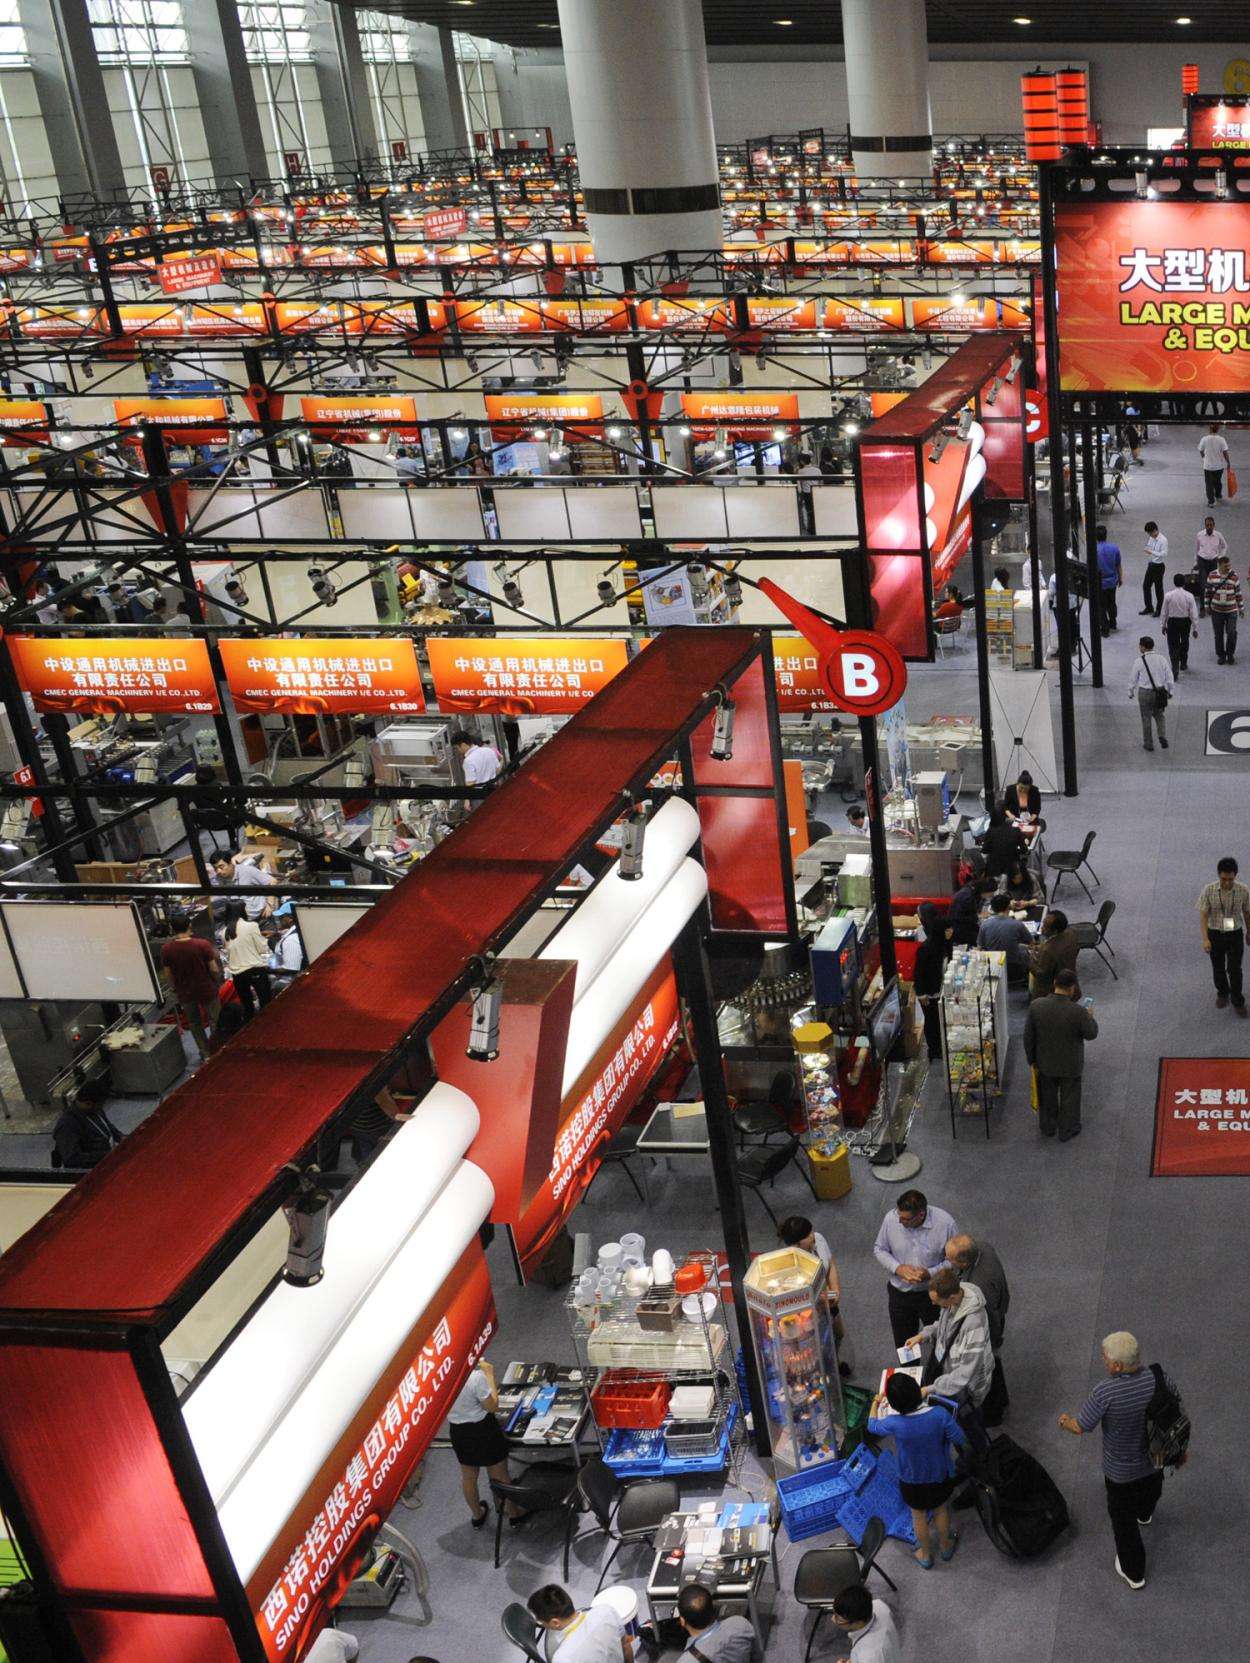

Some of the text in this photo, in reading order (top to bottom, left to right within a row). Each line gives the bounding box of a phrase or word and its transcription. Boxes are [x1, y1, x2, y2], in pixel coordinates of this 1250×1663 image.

[1212, 141, 1246, 149] LARGE
[1119, 301, 1226, 327] LARGE
[1164, 327, 1188, 350] &
[44, 657, 187, 673] 中设通用机械进出口
[248, 657, 393, 673] 中设通用机械进出口
[454, 657, 604, 673] 中设通用机械进出口
[72, 672, 168, 688] 有限责任公司
[276, 672, 373, 688] 有限责任公司
[483, 672, 582, 689] 有限责任公司
[841, 652, 880, 697] B
[43, 689, 67, 697] CMEC
[68, 689, 104, 697] GENERAL
[106, 689, 153, 697] MACHINERY
[245, 689, 270, 697] CMEC
[271, 689, 307, 697] GENERAL
[310, 689, 358, 697] MACHINERY
[451, 689, 475, 697] CMEC
[476, 689, 515, 698] GENERAL
[517, 689, 566, 698] MACHINERY
[1173, 1109, 1234, 1119] LARGE
[1197, 1121, 1211, 1131] &
[552, 1166, 573, 1200] SINO
[572, 1108, 608, 1167] HOLDINGS
[606, 1073, 630, 1113] GROUP
[467, 1321, 493, 1366] 6.1A39
[259, 1315, 452, 1632] 西诺控股集团有限公司
[274, 1591, 310, 1651] SINO
[308, 1492, 373, 1596] HOLDINGS
[372, 1425, 411, 1490] GROUP
